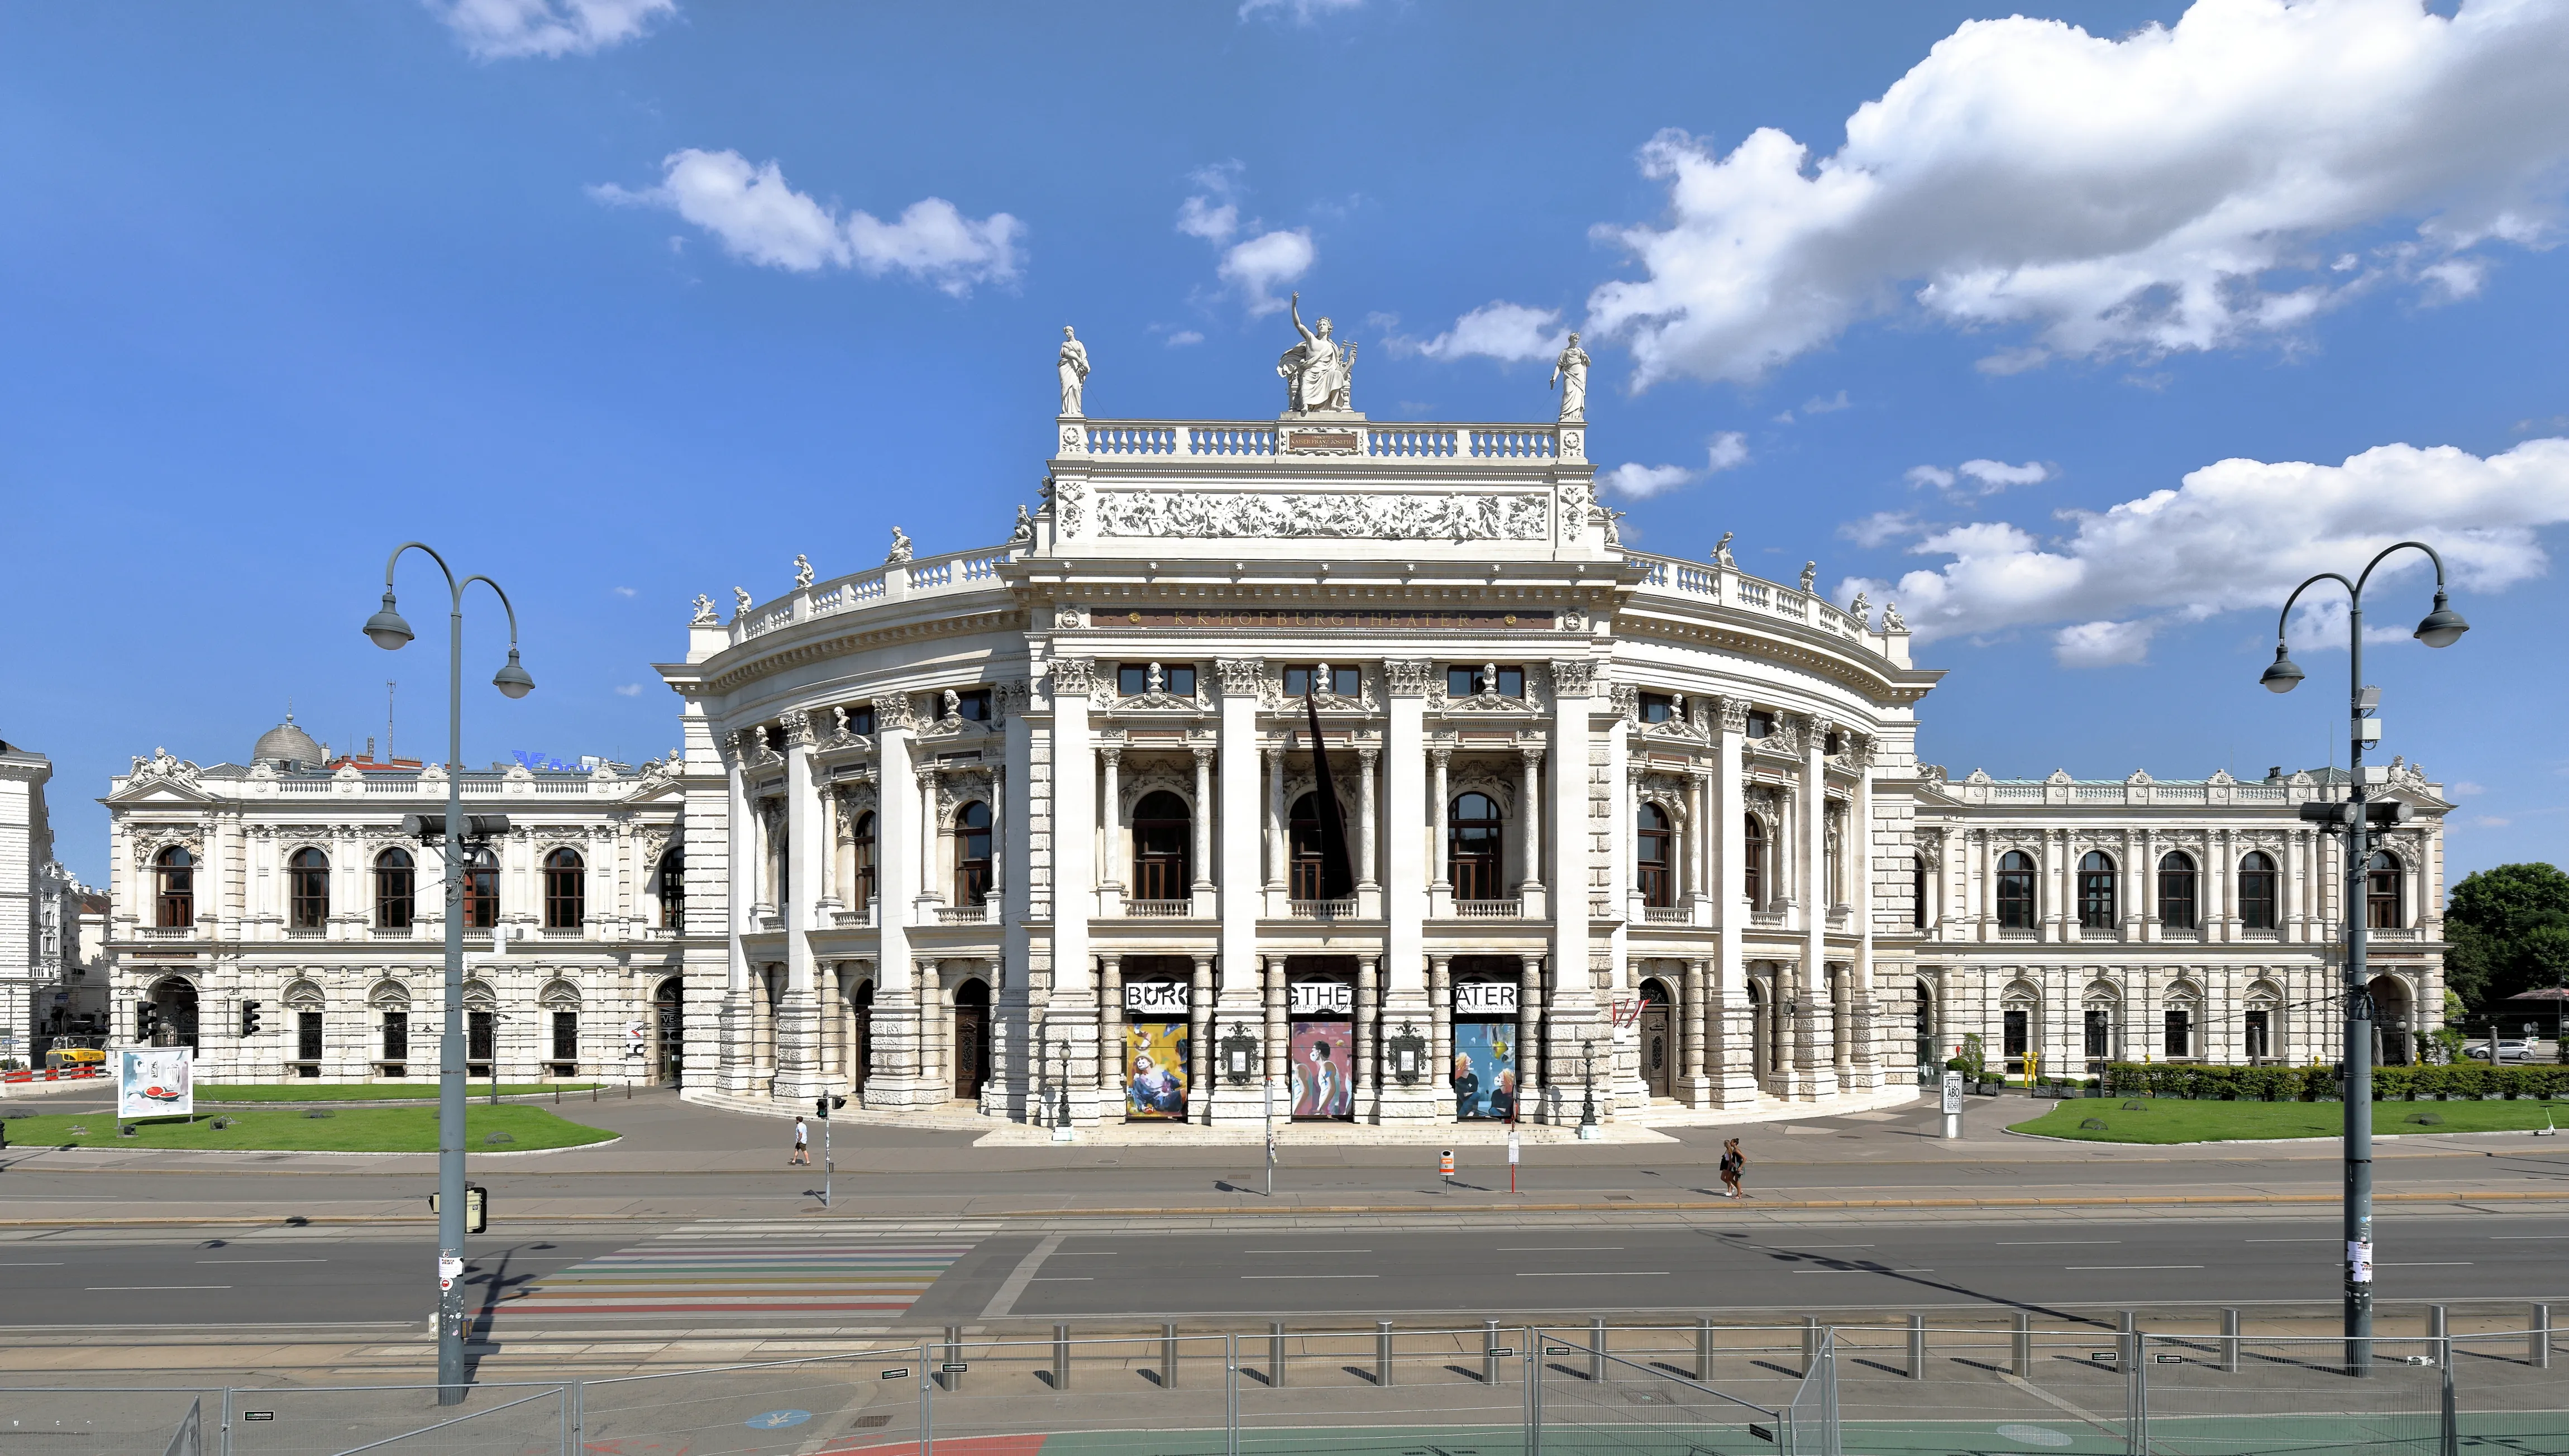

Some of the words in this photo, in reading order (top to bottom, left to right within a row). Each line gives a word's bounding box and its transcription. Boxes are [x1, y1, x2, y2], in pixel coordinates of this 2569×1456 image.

[1456, 986, 1515, 1005] ATER
[1945, 1078, 1960, 1088] JETZT
[1947, 1087, 1960, 1097] ABO
